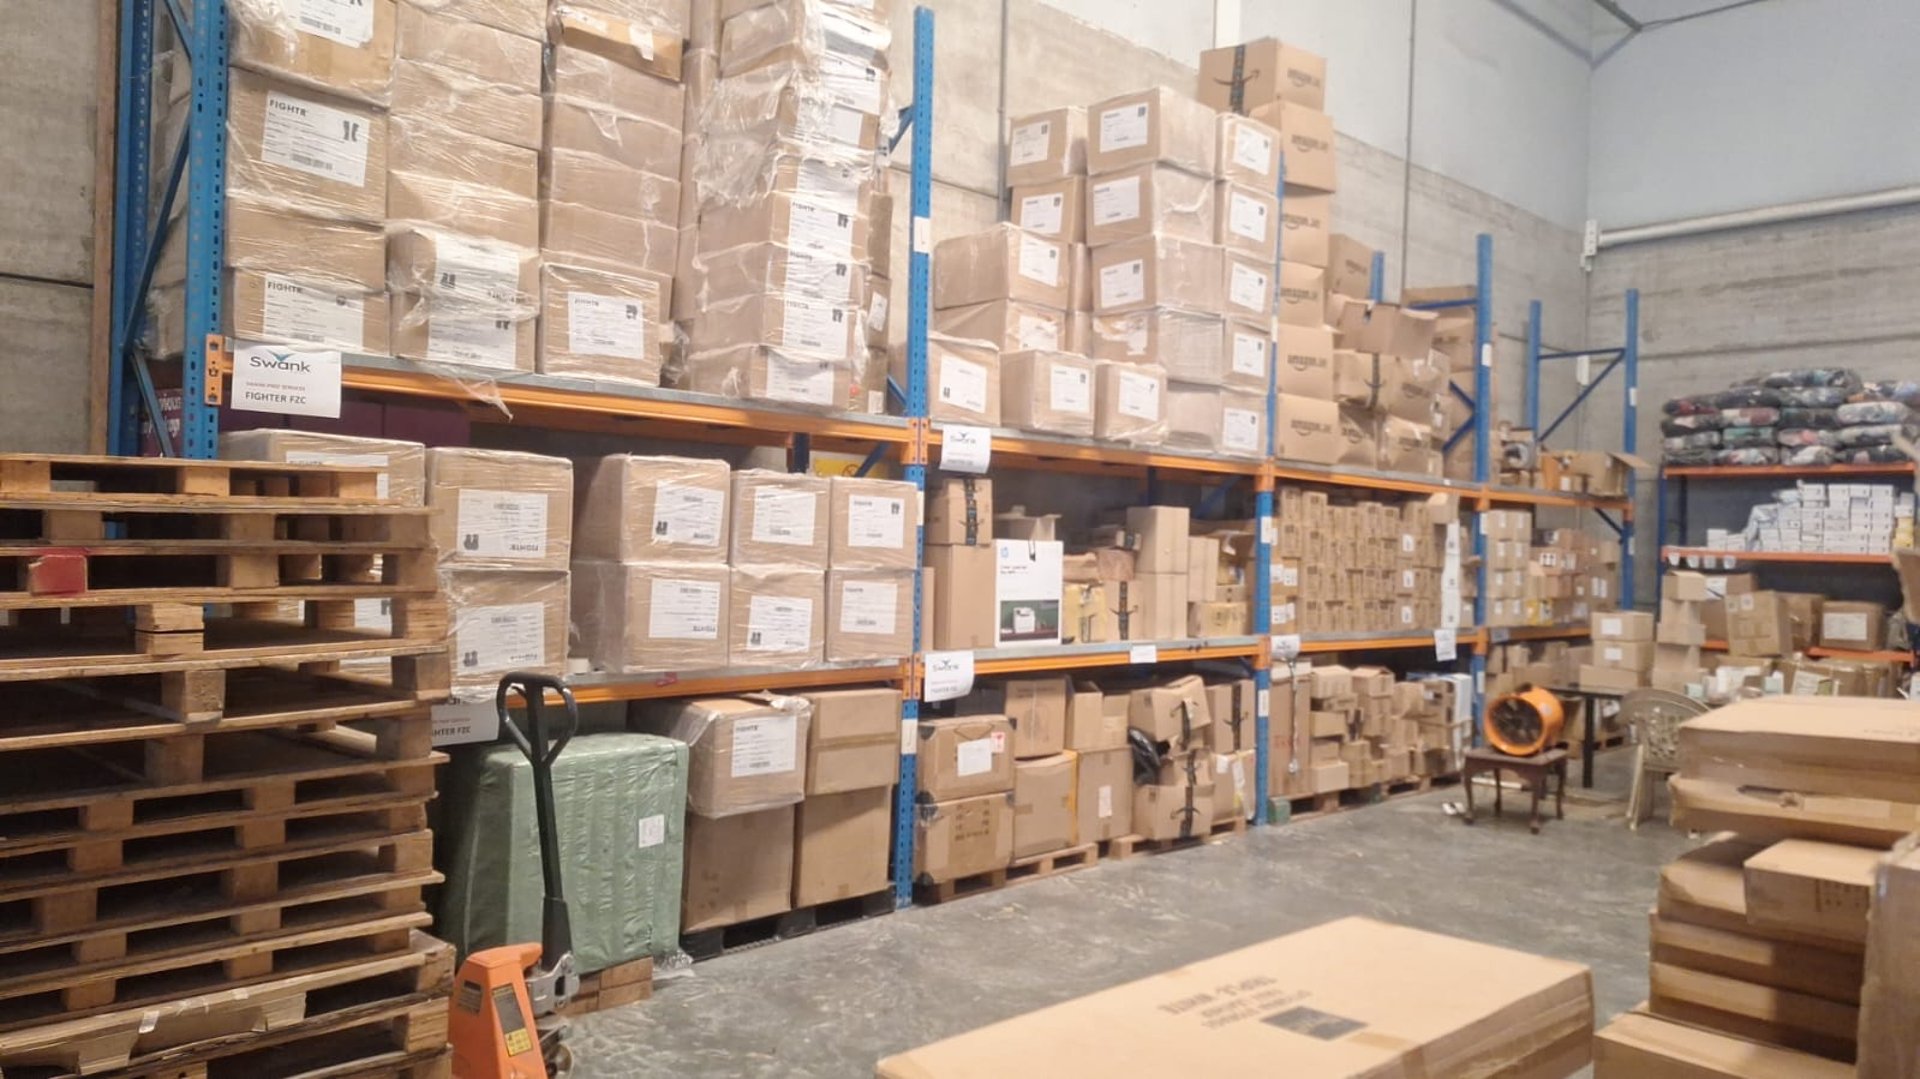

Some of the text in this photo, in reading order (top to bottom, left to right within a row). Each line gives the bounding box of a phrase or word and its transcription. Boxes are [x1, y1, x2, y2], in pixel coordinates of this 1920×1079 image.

[269, 99, 306, 116] FIGHTR
[249, 356, 311, 372] Swank
[245, 391, 306, 404] FIGHTER FZC
